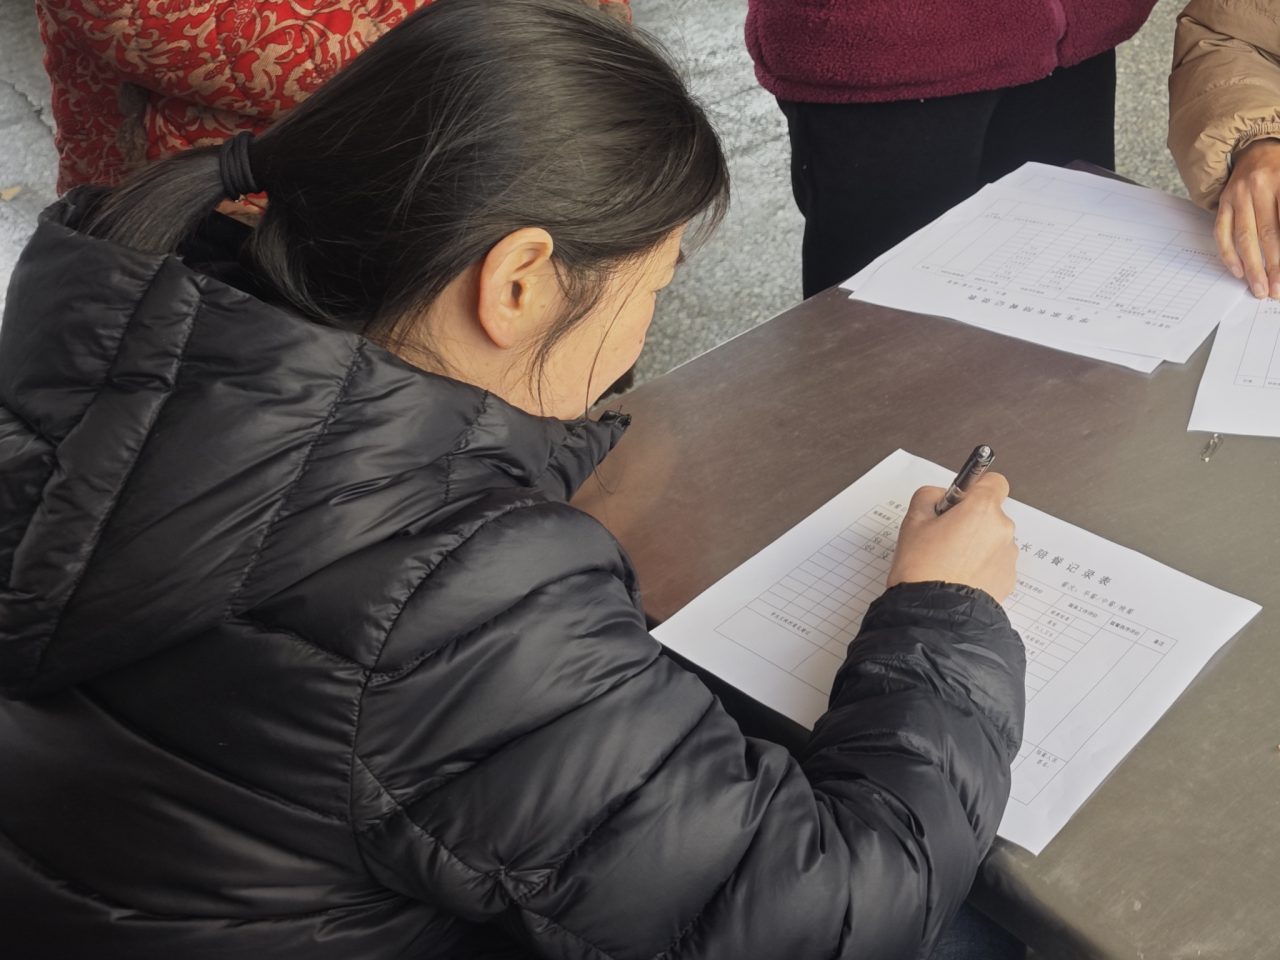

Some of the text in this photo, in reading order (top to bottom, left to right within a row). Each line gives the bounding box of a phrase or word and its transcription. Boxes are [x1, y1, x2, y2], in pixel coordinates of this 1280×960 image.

[1013, 535, 1113, 588] 长陪餐记录表
